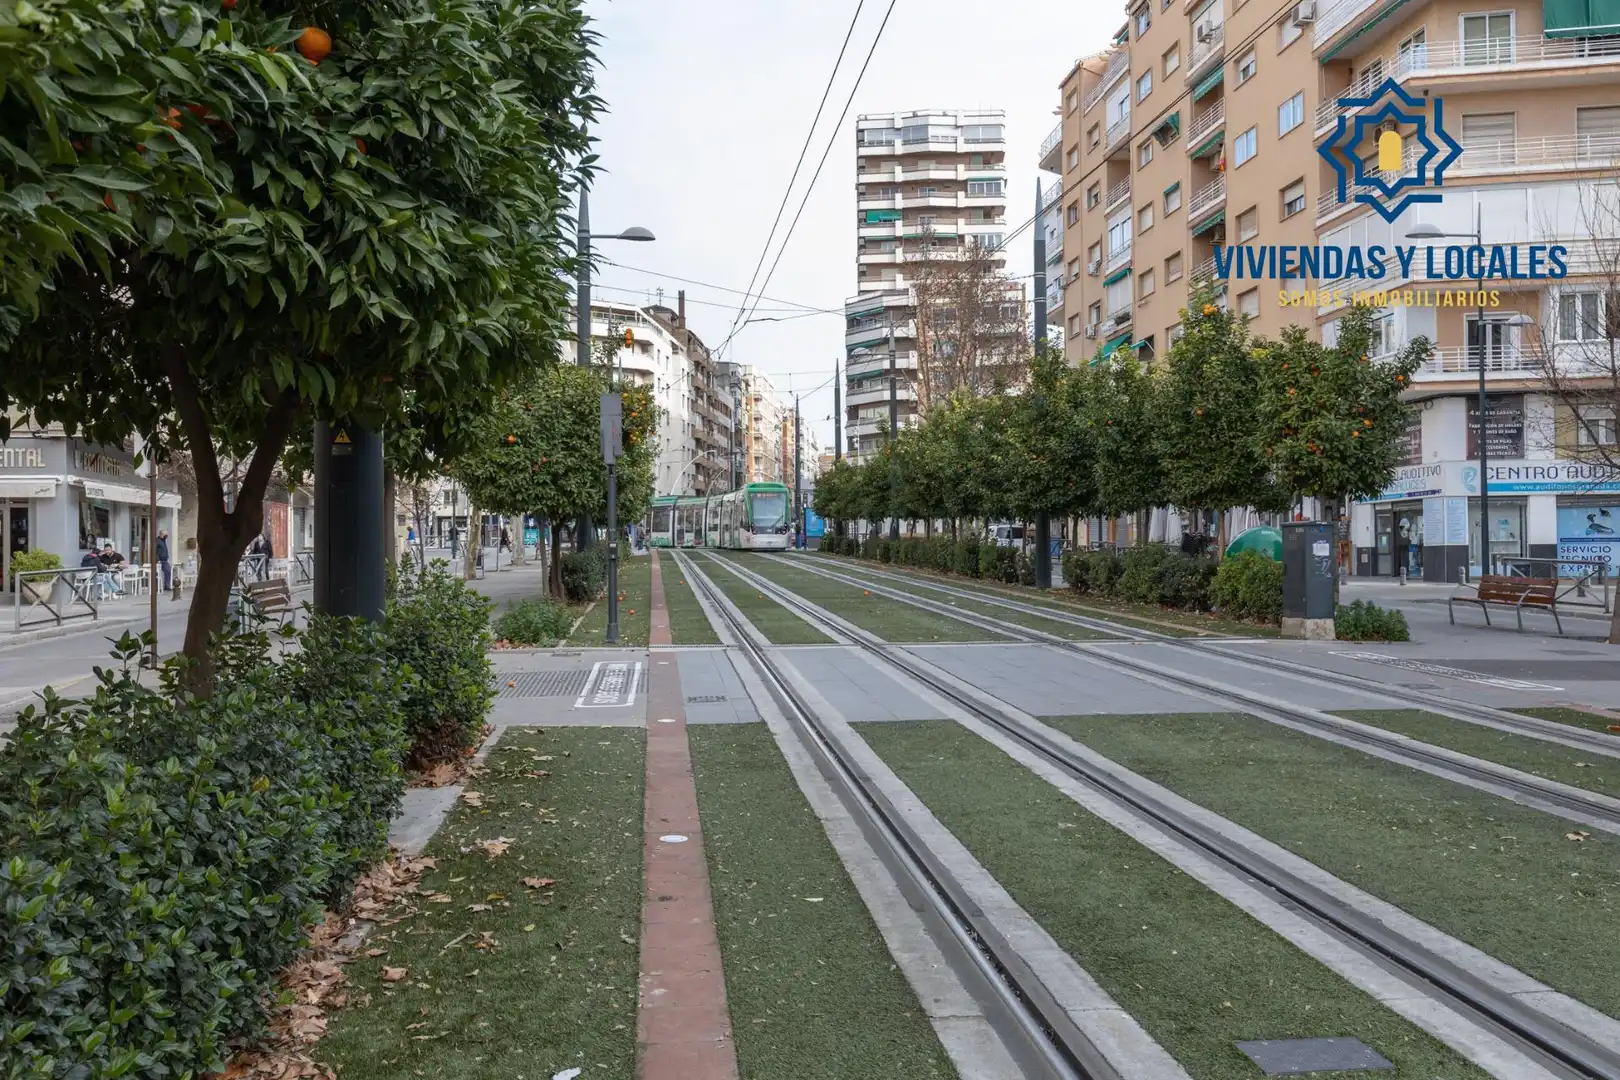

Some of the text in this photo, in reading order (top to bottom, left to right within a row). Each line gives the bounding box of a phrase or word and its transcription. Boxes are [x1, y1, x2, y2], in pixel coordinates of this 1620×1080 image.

[1400, 464, 1441, 481] AUDITIVO
[1487, 466, 1558, 480] CENTRO
[1560, 545, 1612, 554] SERVICIO
